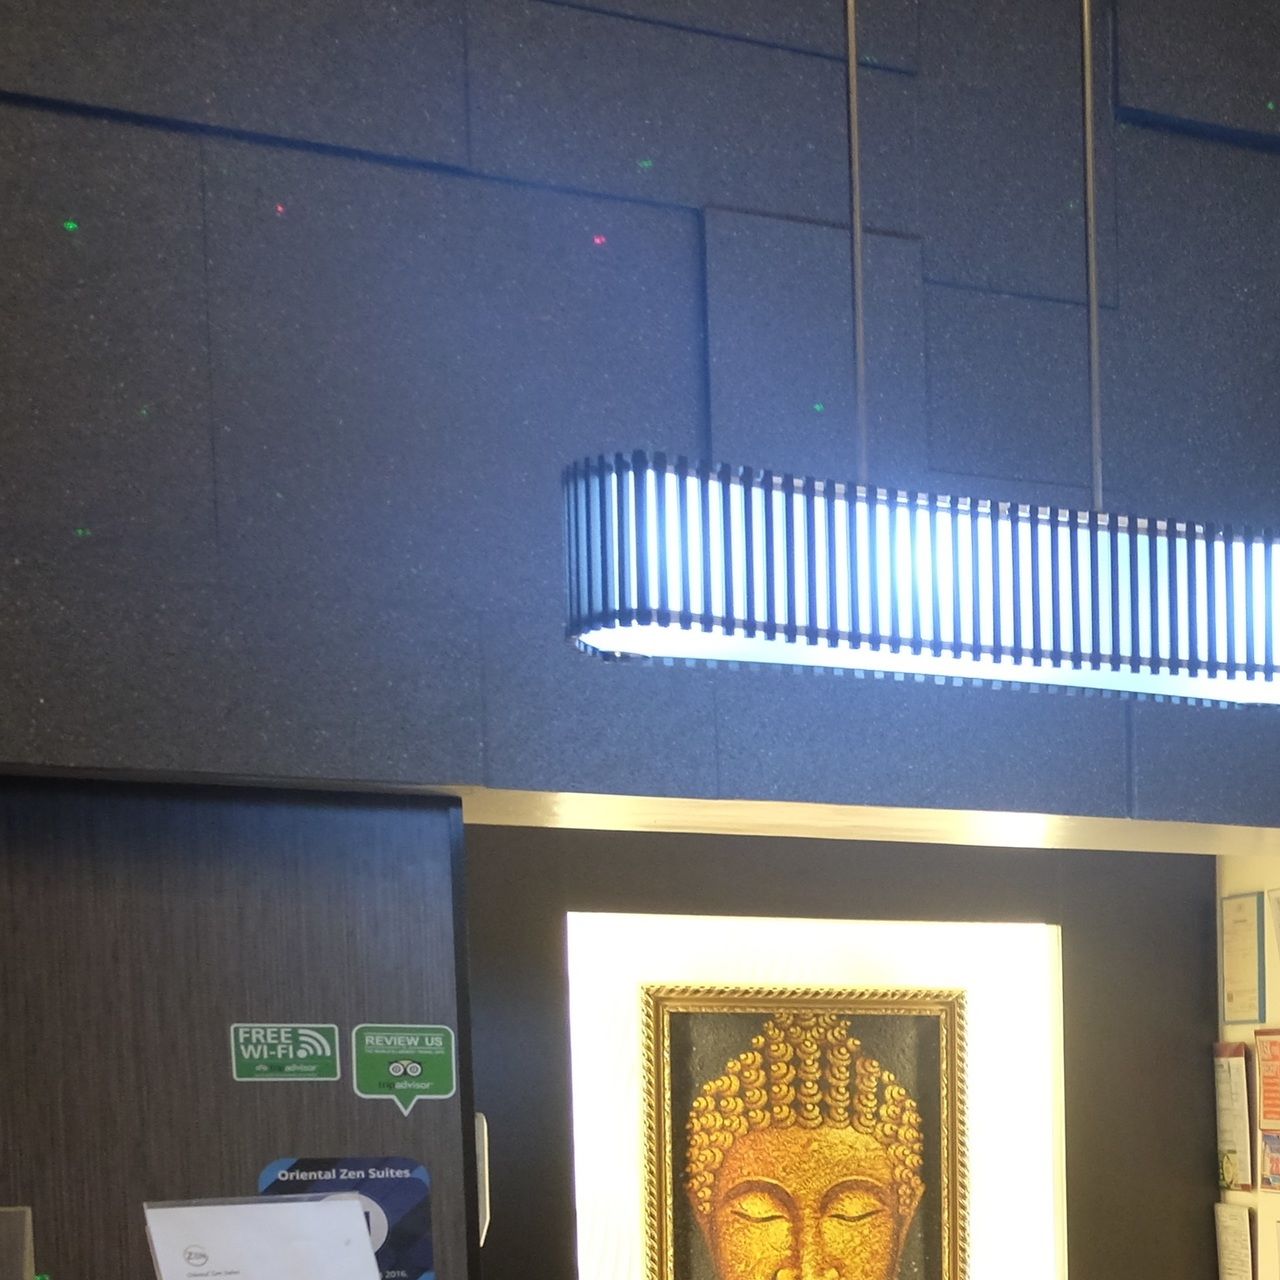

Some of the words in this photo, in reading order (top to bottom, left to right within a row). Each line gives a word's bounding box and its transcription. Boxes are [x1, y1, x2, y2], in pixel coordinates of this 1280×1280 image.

[238, 1027, 293, 1044] FREE
[365, 1035, 420, 1047] REVIEW
[424, 1035, 443, 1047] US
[240, 1044, 294, 1060] WI-FI
[277, 1169, 337, 1182] Oriental
[339, 1168, 365, 1180] Zen
[368, 1167, 411, 1180] Suites
